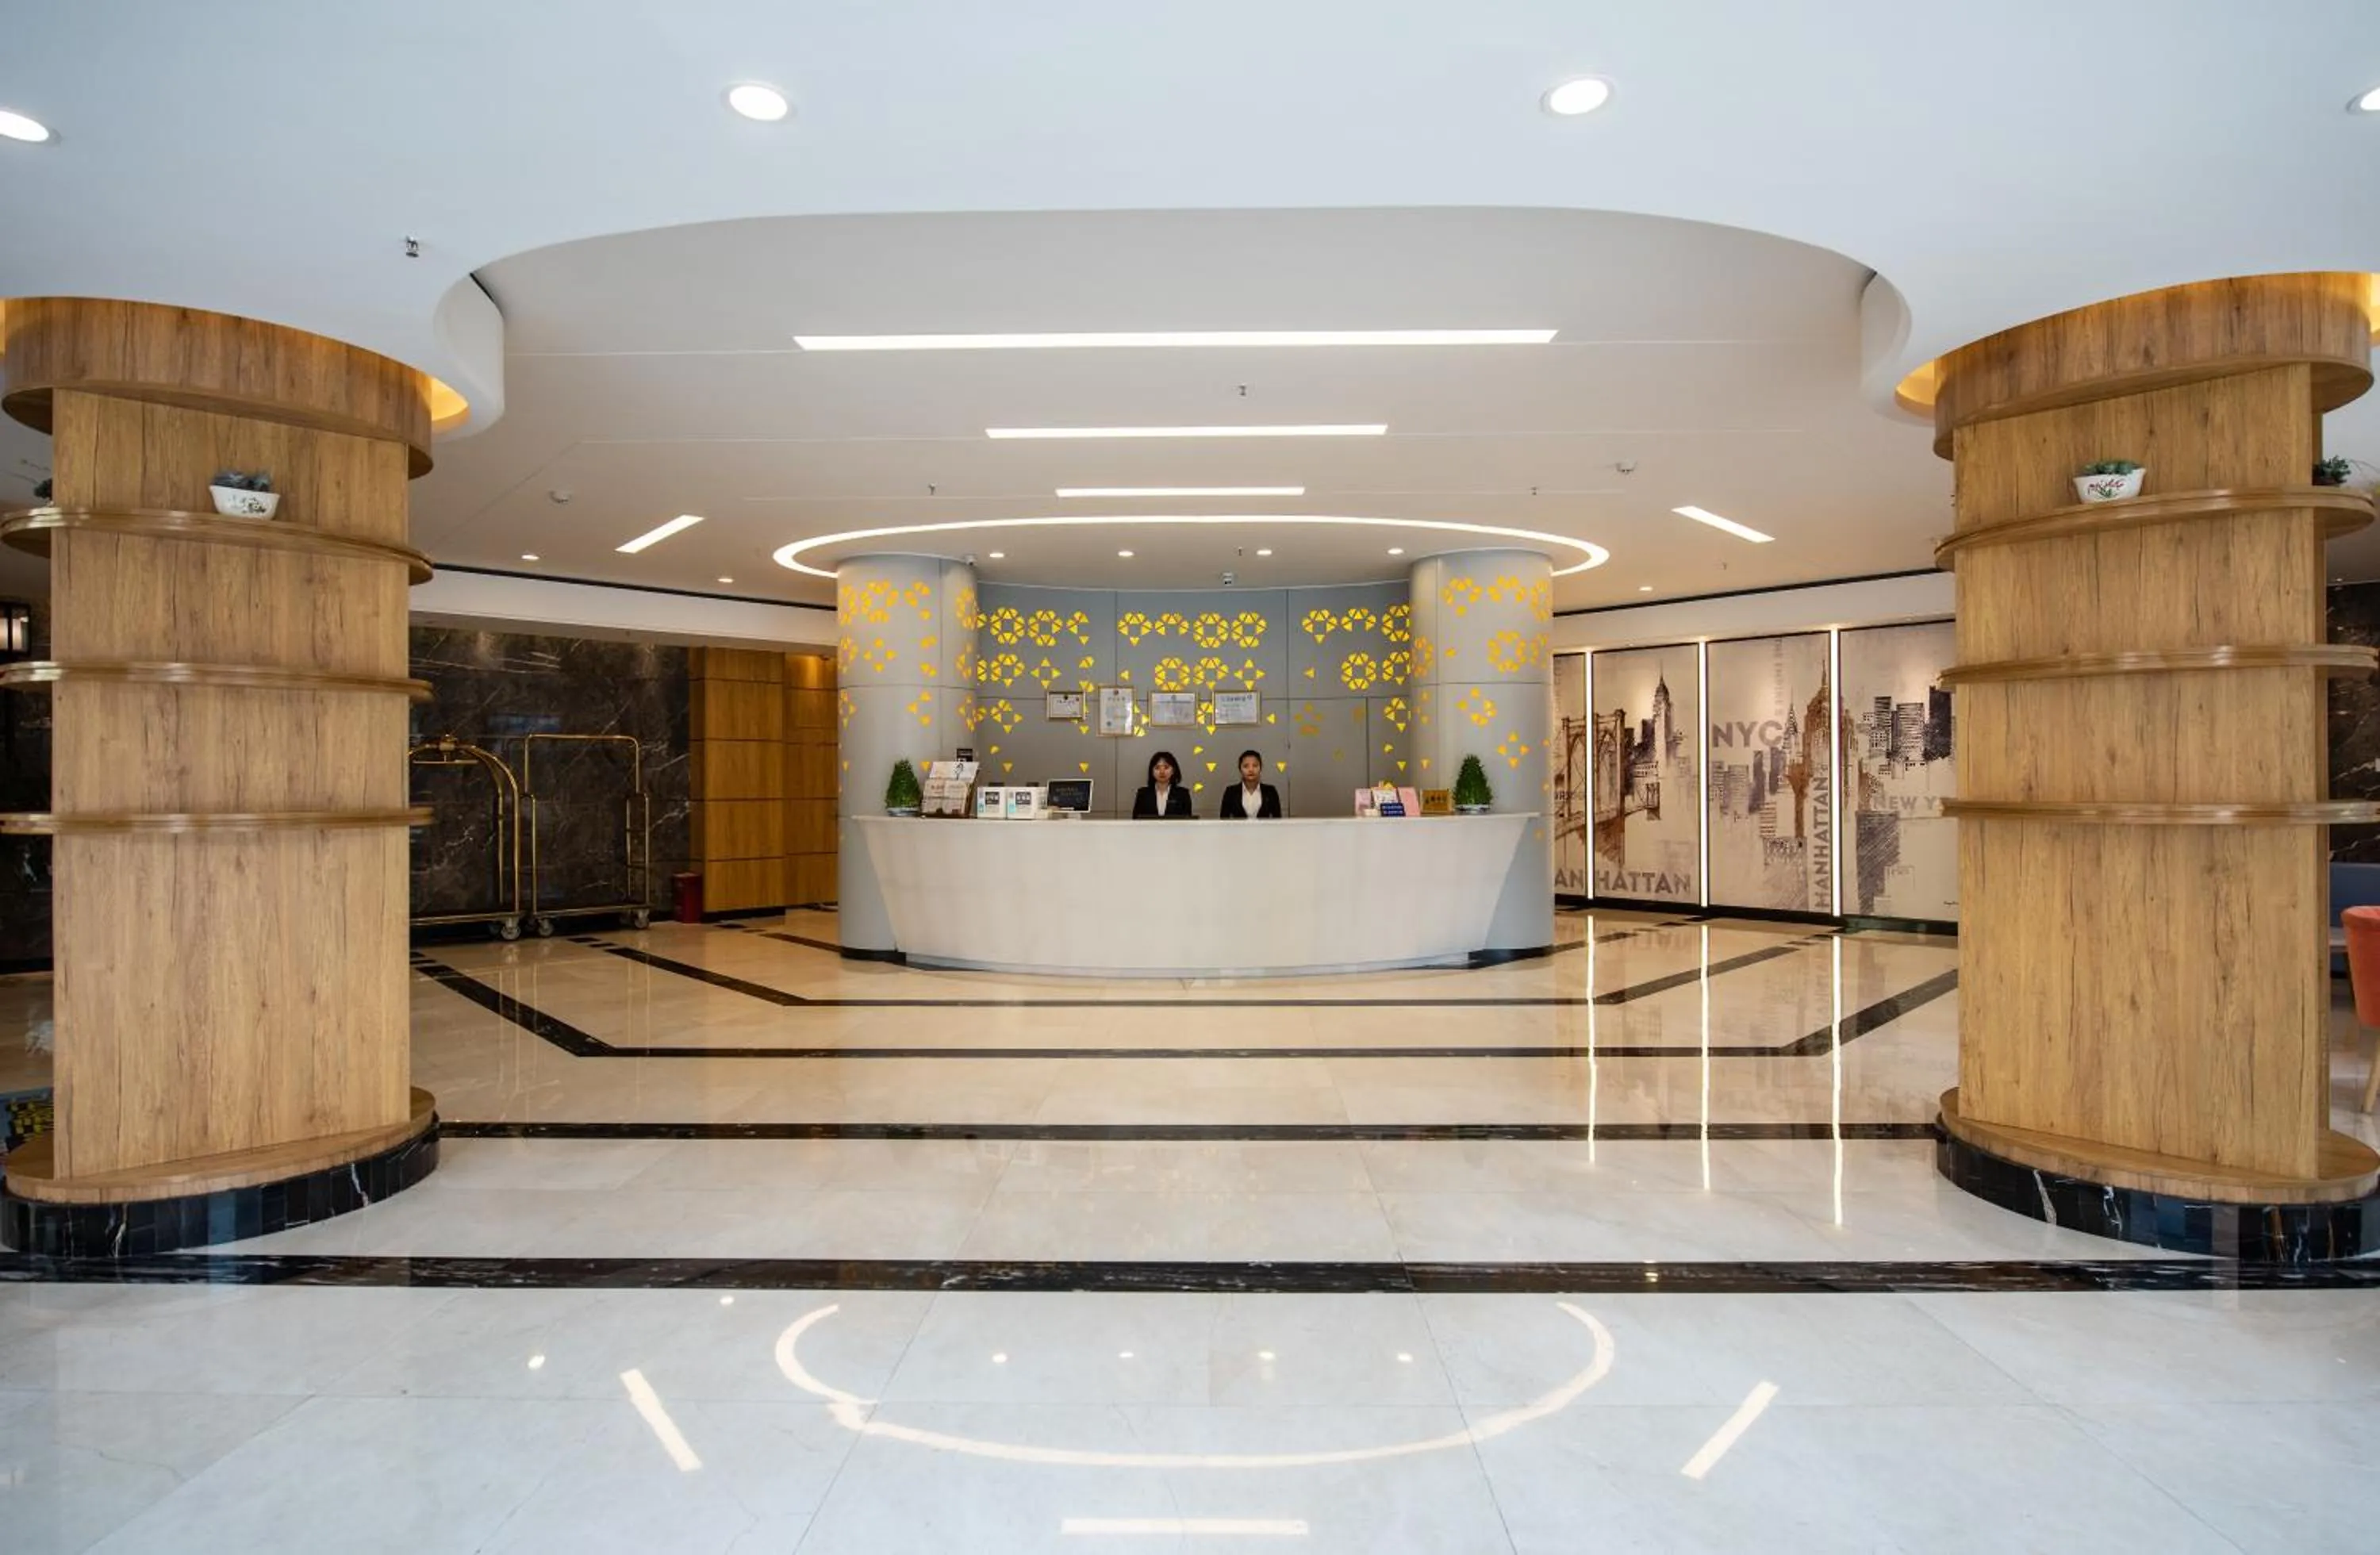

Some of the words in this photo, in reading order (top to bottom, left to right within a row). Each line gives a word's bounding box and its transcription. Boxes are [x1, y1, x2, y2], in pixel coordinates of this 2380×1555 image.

[1712, 720, 1783, 747] NYC
[1873, 796, 1917, 811] NEW
[1813, 778, 1829, 908] MANHATTAN
[1554, 868, 1691, 894] ANHATTAN
